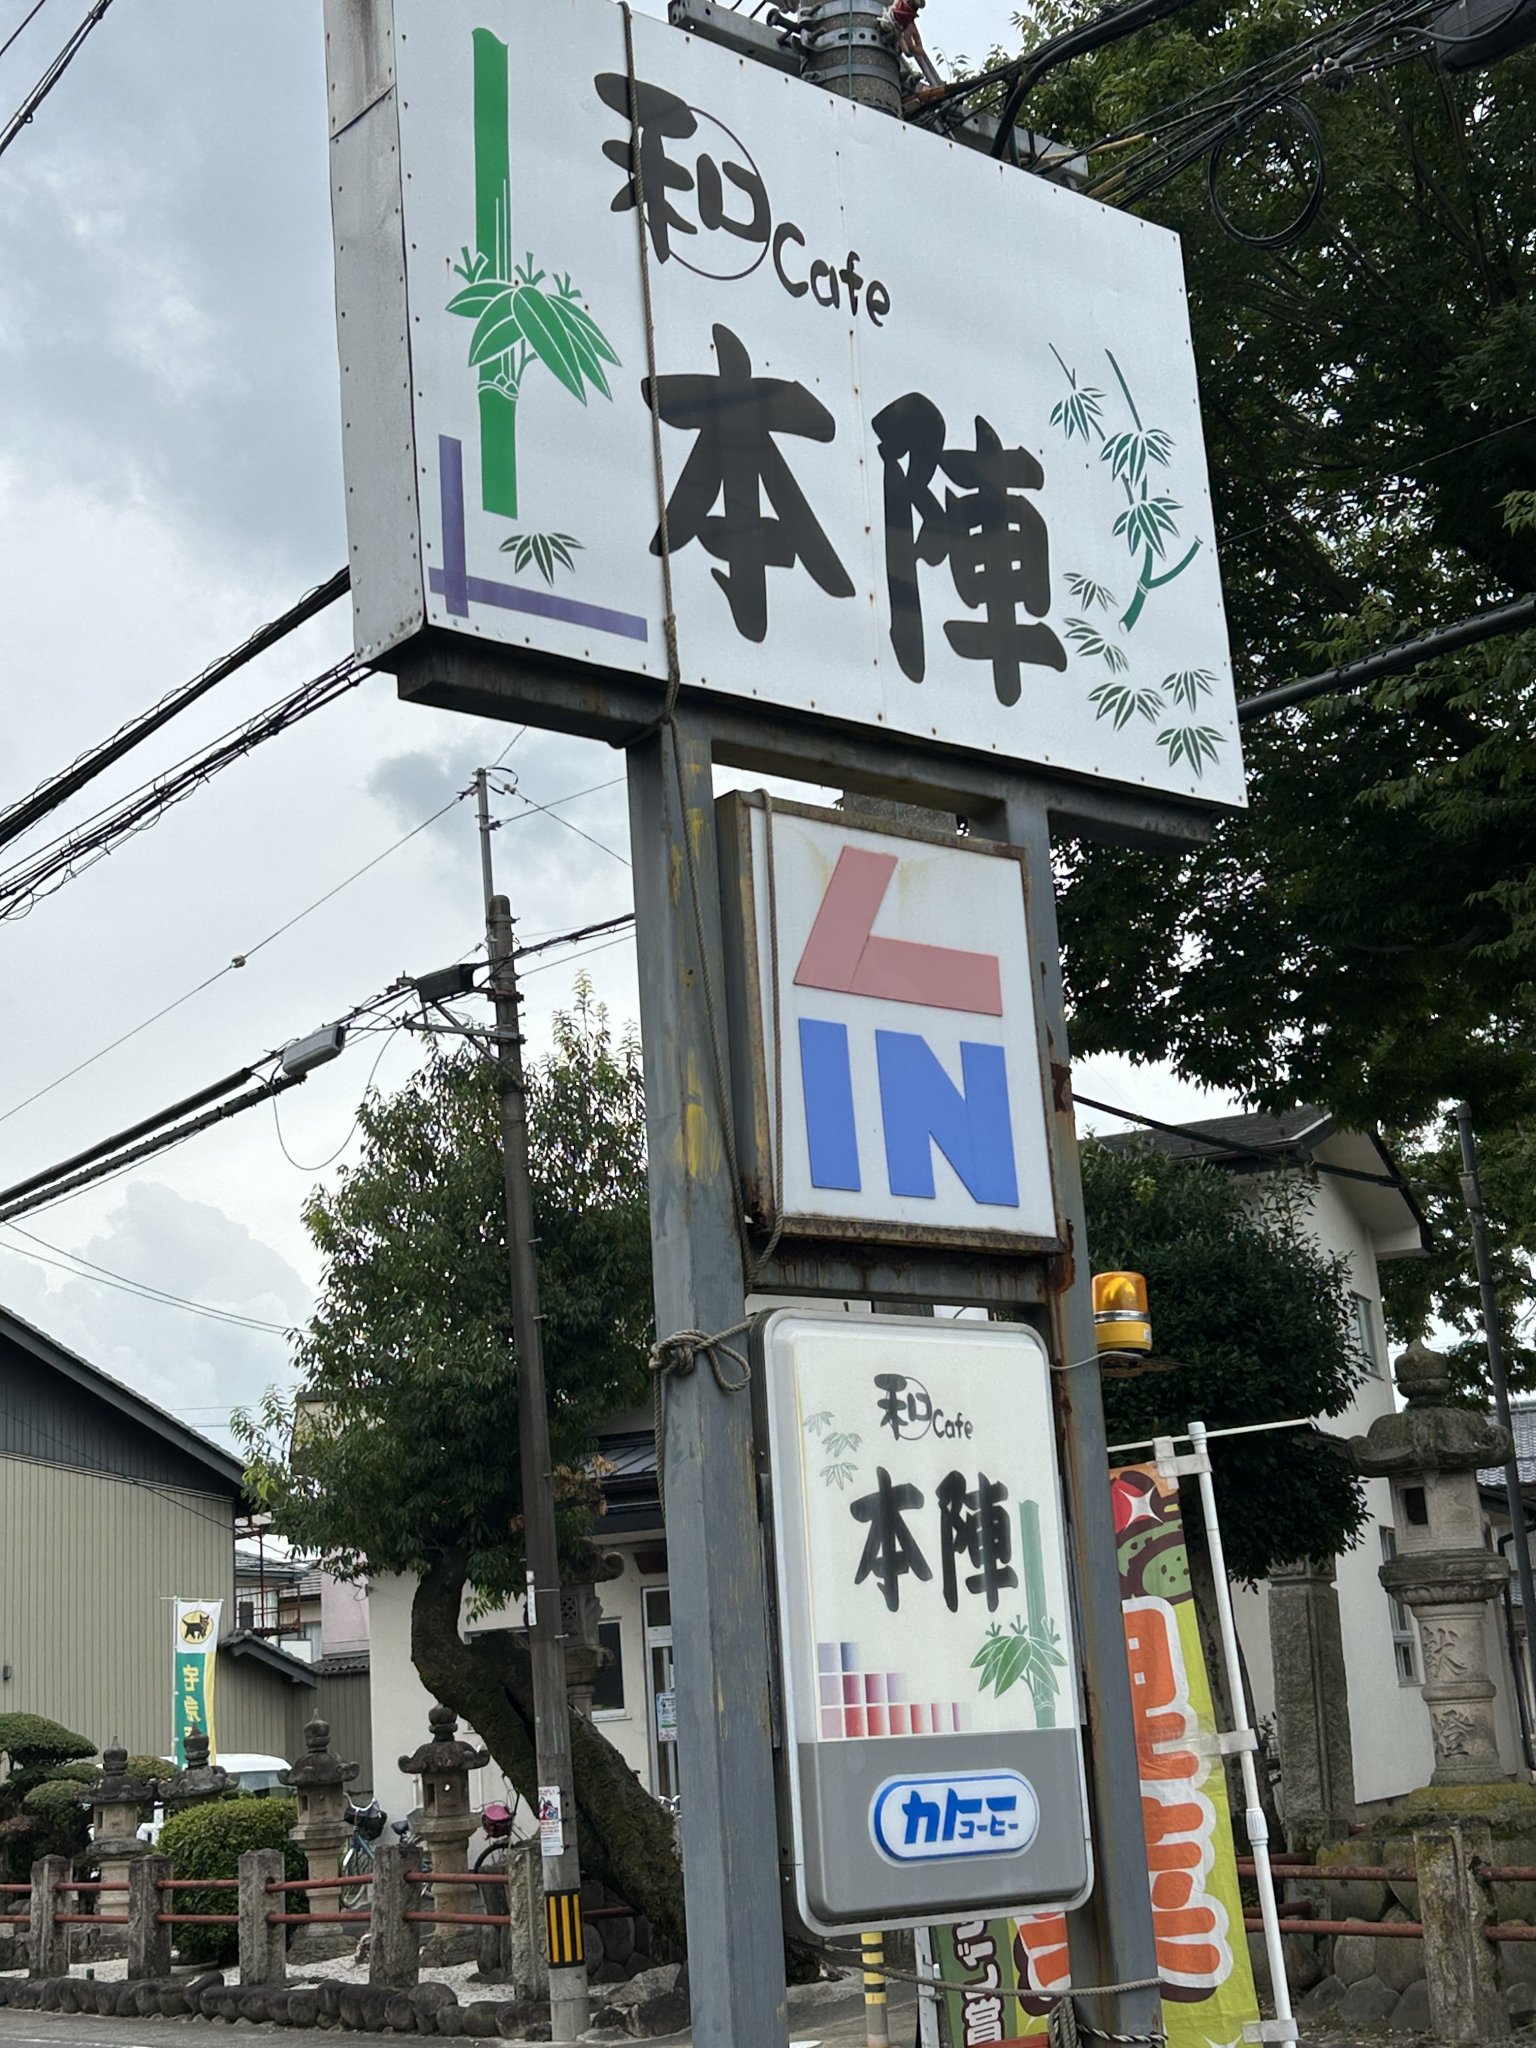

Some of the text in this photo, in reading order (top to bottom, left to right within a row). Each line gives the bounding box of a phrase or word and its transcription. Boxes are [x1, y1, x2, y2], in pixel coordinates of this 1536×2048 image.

[641, 323, 1068, 707] 本陣
[798, 1017, 1019, 1207] IN
[850, 1466, 1019, 1613] 本陣
[902, 1787, 1017, 1845] カトー
[958, 1815, 1018, 1840] コーヒー
